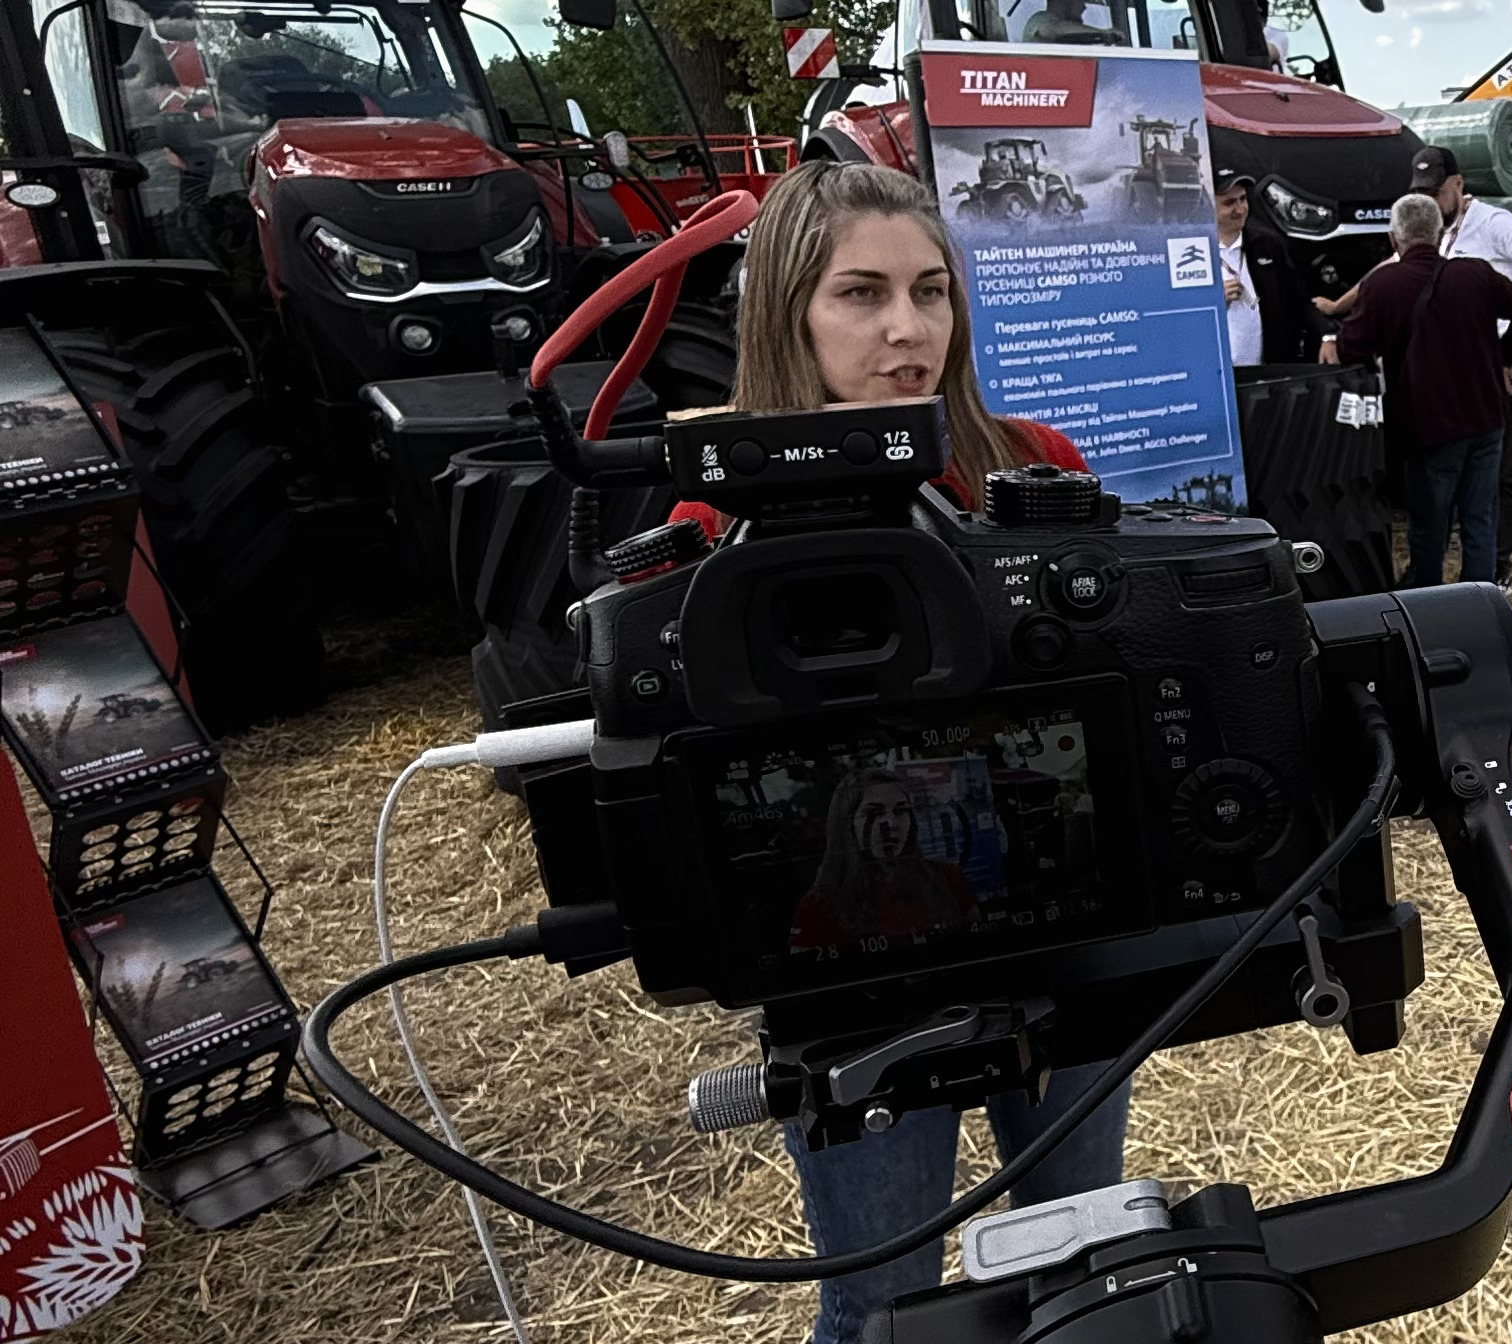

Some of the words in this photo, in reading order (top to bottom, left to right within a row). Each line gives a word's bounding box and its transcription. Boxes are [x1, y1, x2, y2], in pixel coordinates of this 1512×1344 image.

[960, 70, 1027, 90] TITAN
[980, 93, 1068, 107] MACHINERY
[396, 182, 437, 192] CASE
[1354, 209, 1392, 220] CASE
[974, 246, 1024, 262] ТАЙТЕН
[1026, 243, 1089, 260] МАШИНЕРІ
[1090, 240, 1137, 256] УКРАЇНА
[976, 262, 1042, 276] ПРОПОНУЄ
[1044, 258, 1089, 273] НАДІЙНІ
[1091, 259, 1105, 270] ТА
[978, 278, 1035, 293] ГУСЕНИЦІ
[1037, 275, 1078, 289] CAMSO
[1079, 271, 1123, 285] РІЗНОГО
[979, 289, 1063, 307] ТИПОРОЗМІРУ
[994, 321, 1050, 335] Переваги
[998, 333, 1083, 353] МАКСИМАЛЬНИЙ
[1084, 331, 1116, 345] РЕСУРС
[1002, 375, 1039, 389] КРАЩА
[1040, 372, 1063, 384] ТЯГА
[1053, 407, 1066, 418] 24
[884, 431, 911, 444] 1/2
[784, 447, 825, 462] M/St
[702, 468, 726, 482] dB
[994, 555, 1032, 568] AFS/AFF
[1005, 574, 1023, 585] AFC
[1071, 576, 1096, 588] AF/AE
[1073, 587, 1097, 598] LOCK
[1010, 594, 1025, 607] MF
[664, 631, 680, 644] Fn
[671, 659, 684, 670] LV
[1161, 686, 1181, 699] Fn2
[1154, 711, 1162, 722] Q
[1163, 709, 1191, 721] MENU
[1166, 734, 1186, 745] Fn3
[1216, 803, 1240, 816] MENU
[1184, 888, 1204, 900] Fn4
